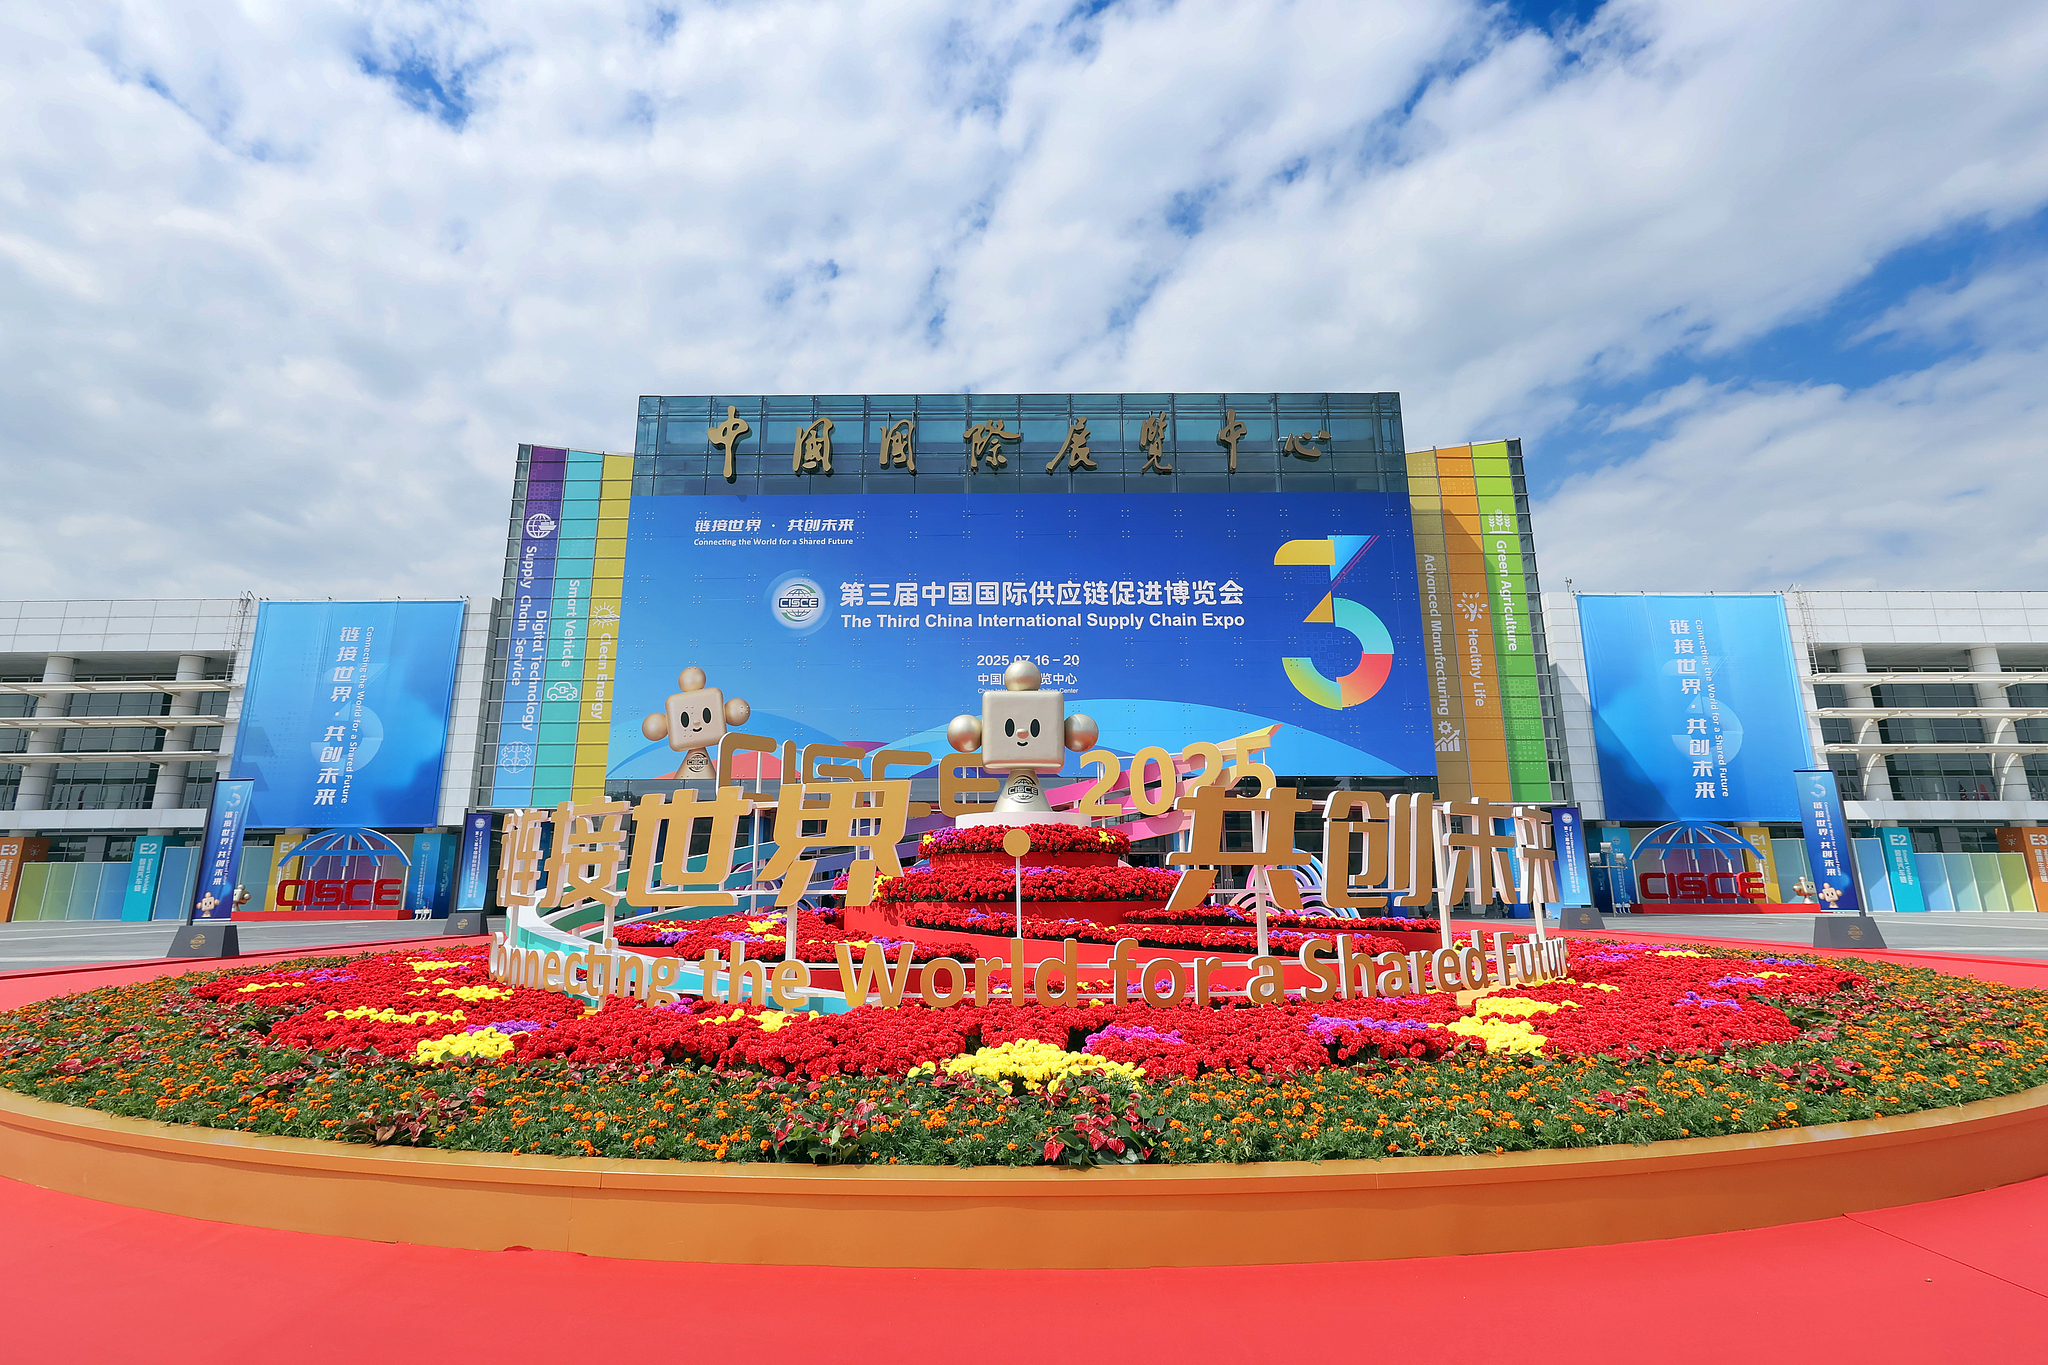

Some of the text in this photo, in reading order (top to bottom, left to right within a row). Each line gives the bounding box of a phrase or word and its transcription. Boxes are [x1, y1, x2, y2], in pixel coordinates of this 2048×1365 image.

[693, 538, 737, 547] Connecting
[738, 538, 751, 546] the
[753, 538, 777, 546] World
[799, 537, 826, 545] Shared
[827, 537, 854, 545] Future
[779, 598, 818, 608] CISCE
[840, 580, 1244, 607] 第三届中国国际供应链促进博览会
[1496, 540, 1518, 651] Green Agriculture
[511, 546, 537, 686] Supply Chain Service
[561, 579, 580, 668] Smart Vehicle
[841, 612, 1245, 630] The Third China International Supply Chain Expo
[1424, 554, 1450, 716] Advanced Manufacturing
[1695, 619, 1710, 665] Connecting
[358, 626, 375, 673] Connecting
[522, 610, 547, 732] Digital Technology
[590, 632, 612, 719] Clean Energy
[977, 673, 1078, 685] 中国览中心
[1467, 628, 1487, 707] Healthy Life
[1704, 666, 1712, 682] the
[357, 674, 368, 689] the
[354, 690, 366, 717] World
[1707, 683, 1719, 710] World
[351, 719, 361, 733] for
[1710, 712, 1721, 726] for
[346, 741, 358, 772] Shared
[1715, 734, 1727, 765] Shared
[341, 774, 353, 804] Future
[1079, 734, 1277, 817] 2025
[1719, 768, 1729, 797] Future
[0, 844, 19, 856] E3
[139, 843, 158, 854] E2
[1749, 834, 1766, 846] E1
[1889, 834, 1908, 846] E2
[2029, 834, 2048, 846] E3
[276, 878, 403, 906] CISCE
[1639, 872, 1767, 899] CISCE
[488, 930, 1571, 1008] Connecting the World for a Shared Futur
